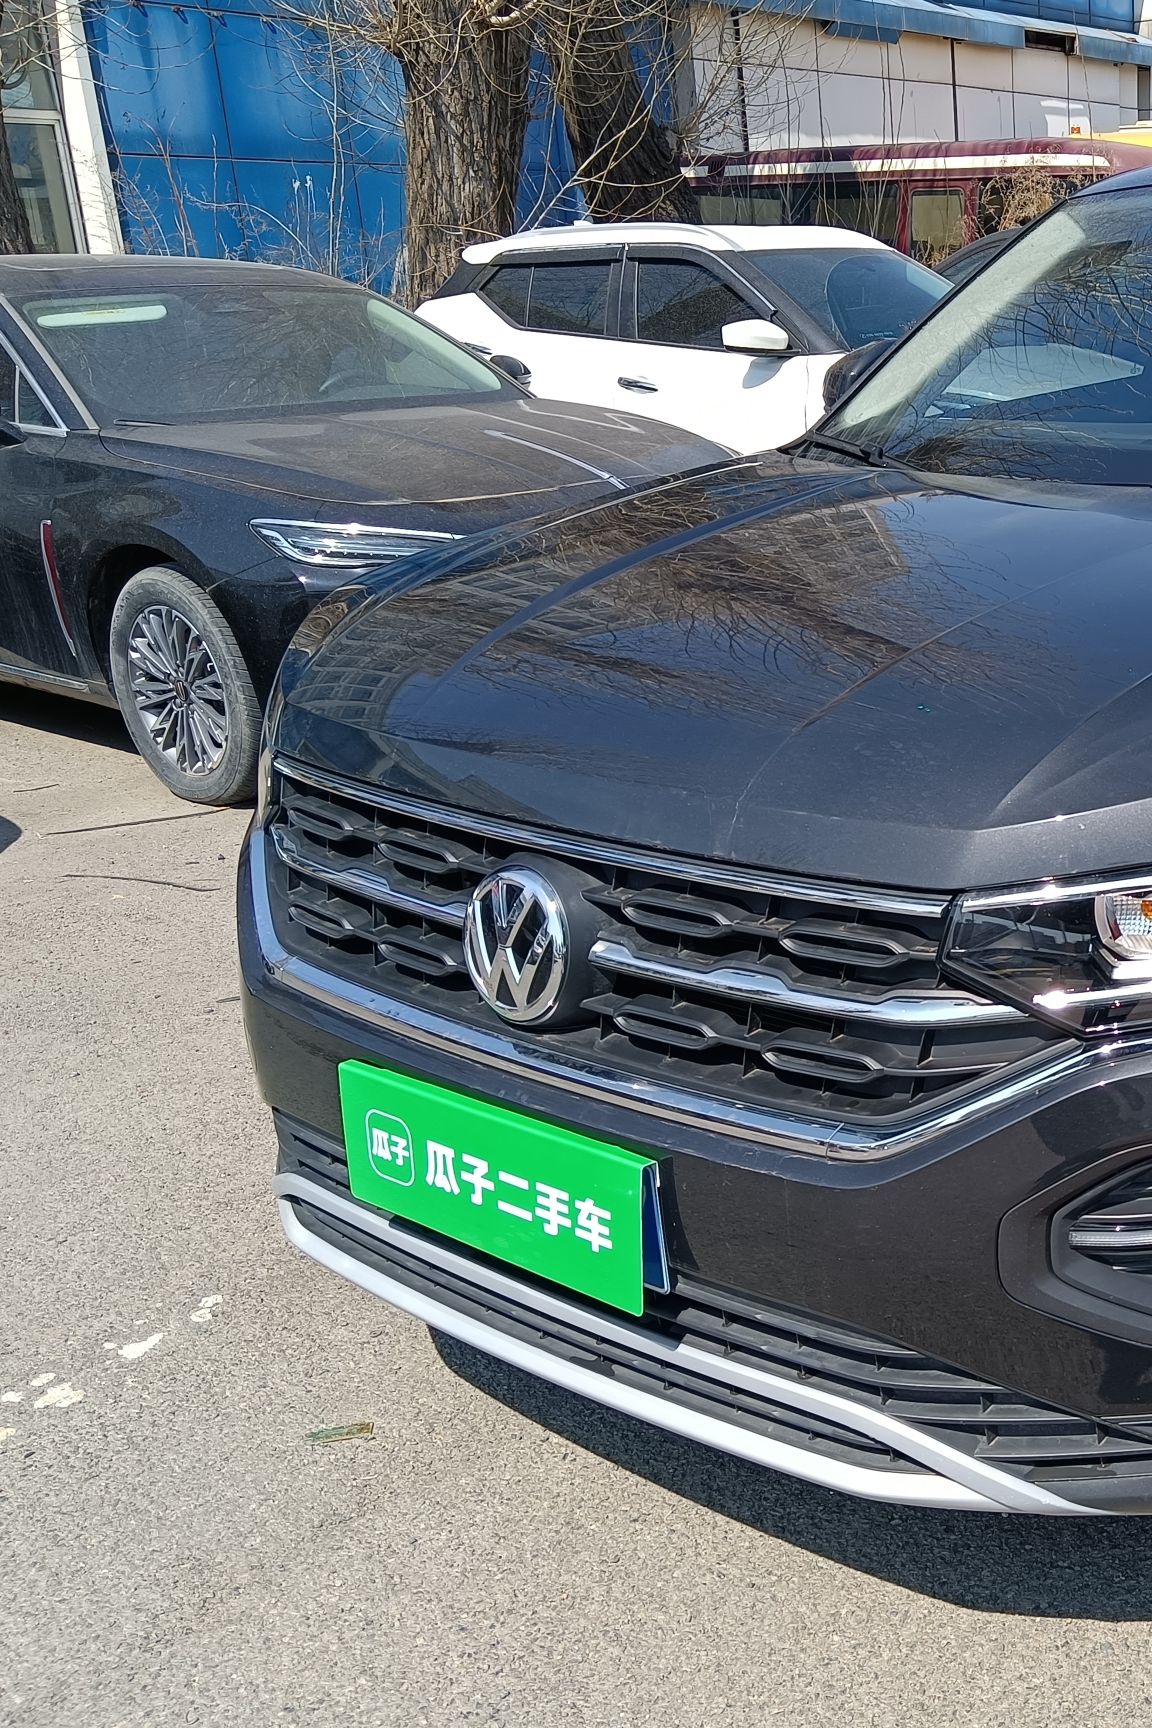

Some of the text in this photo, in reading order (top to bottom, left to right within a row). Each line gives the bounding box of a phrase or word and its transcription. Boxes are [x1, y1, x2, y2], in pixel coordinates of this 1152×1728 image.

[371, 1126, 410, 1167] 瓜子
[425, 1139, 613, 1252] 瓜子二手车
